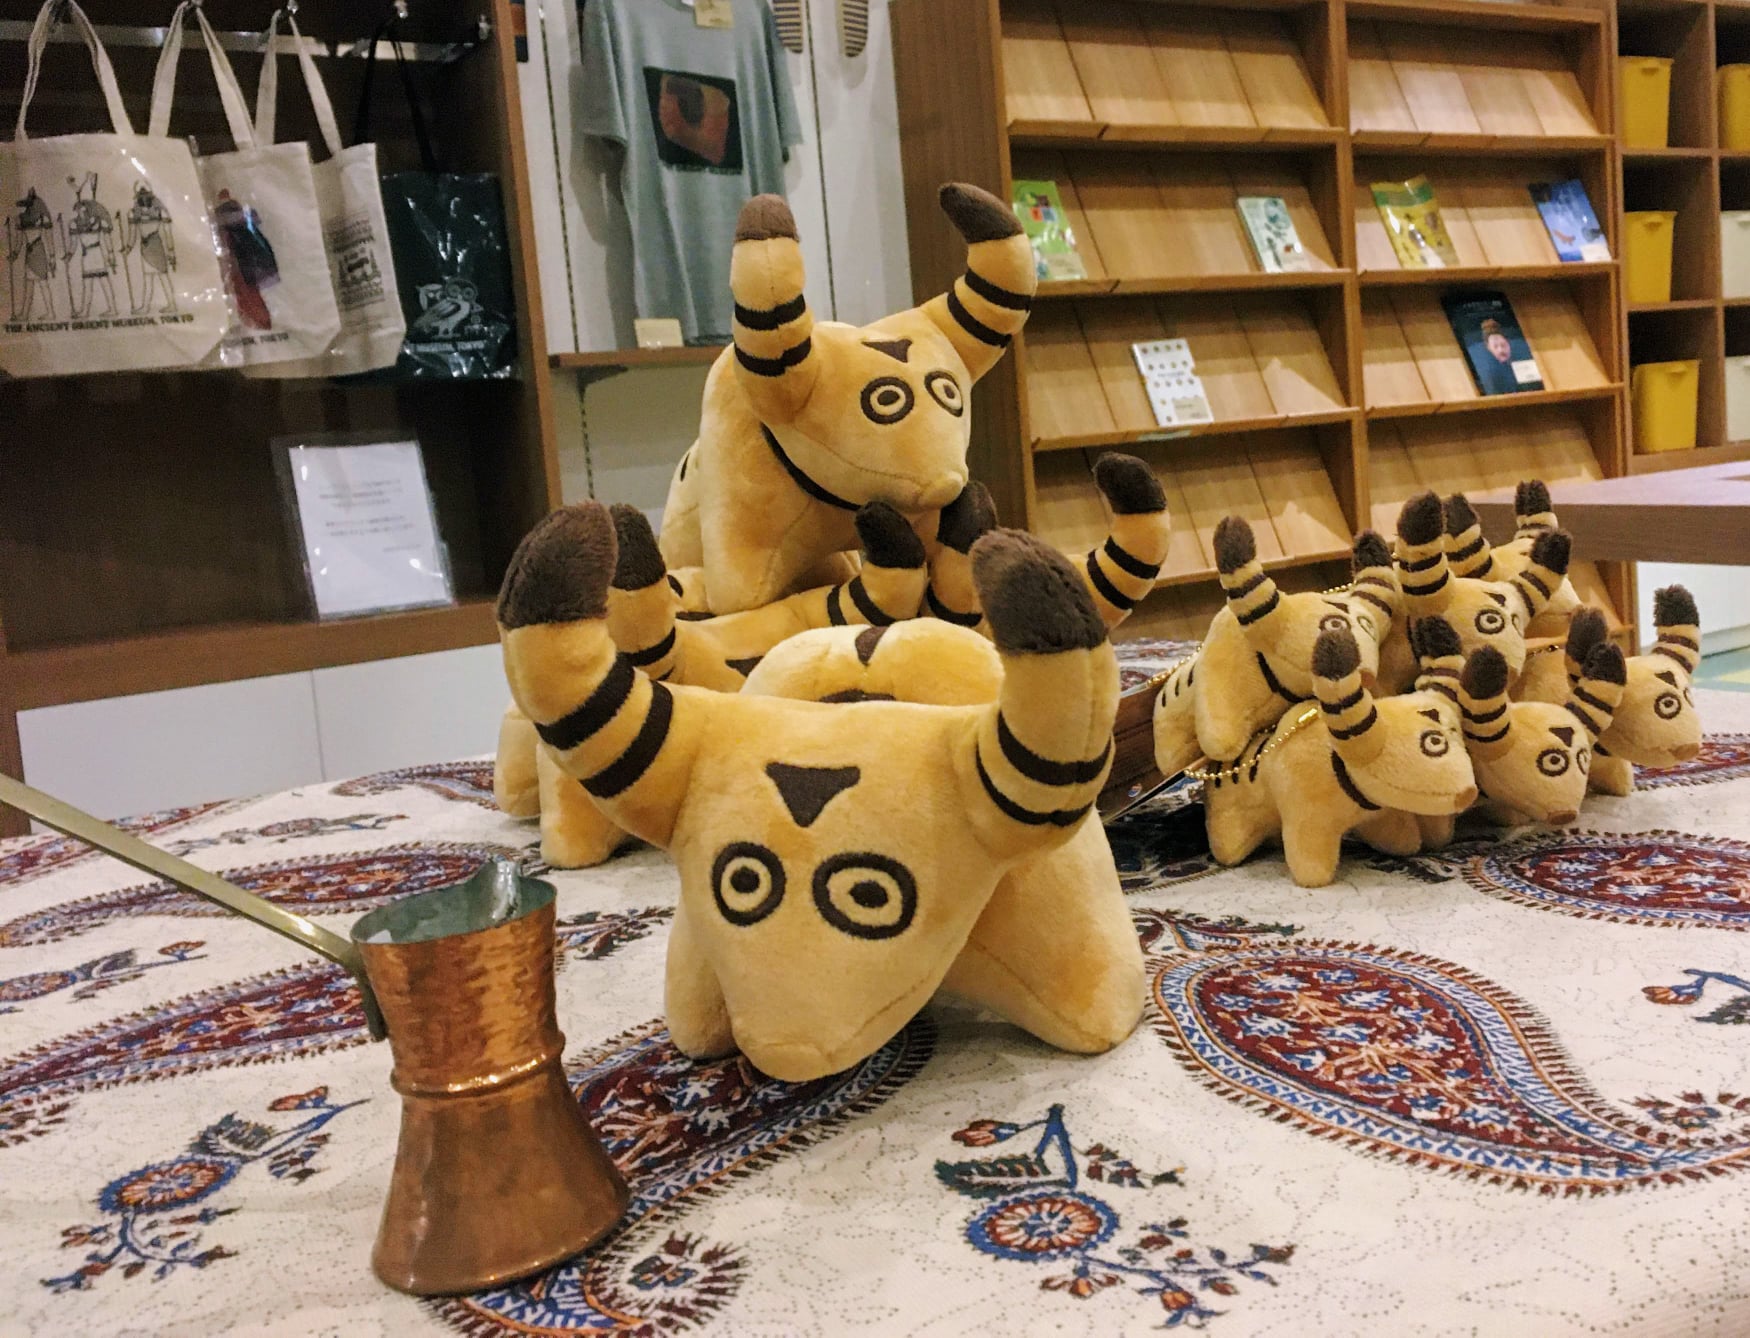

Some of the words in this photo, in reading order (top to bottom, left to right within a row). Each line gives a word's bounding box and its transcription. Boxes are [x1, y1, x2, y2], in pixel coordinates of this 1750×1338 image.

[4, 323, 22, 333] THE
[26, 321, 69, 332] ANCIENT
[71, 320, 109, 331] ORIENT
[160, 313, 194, 325] TOKYO
